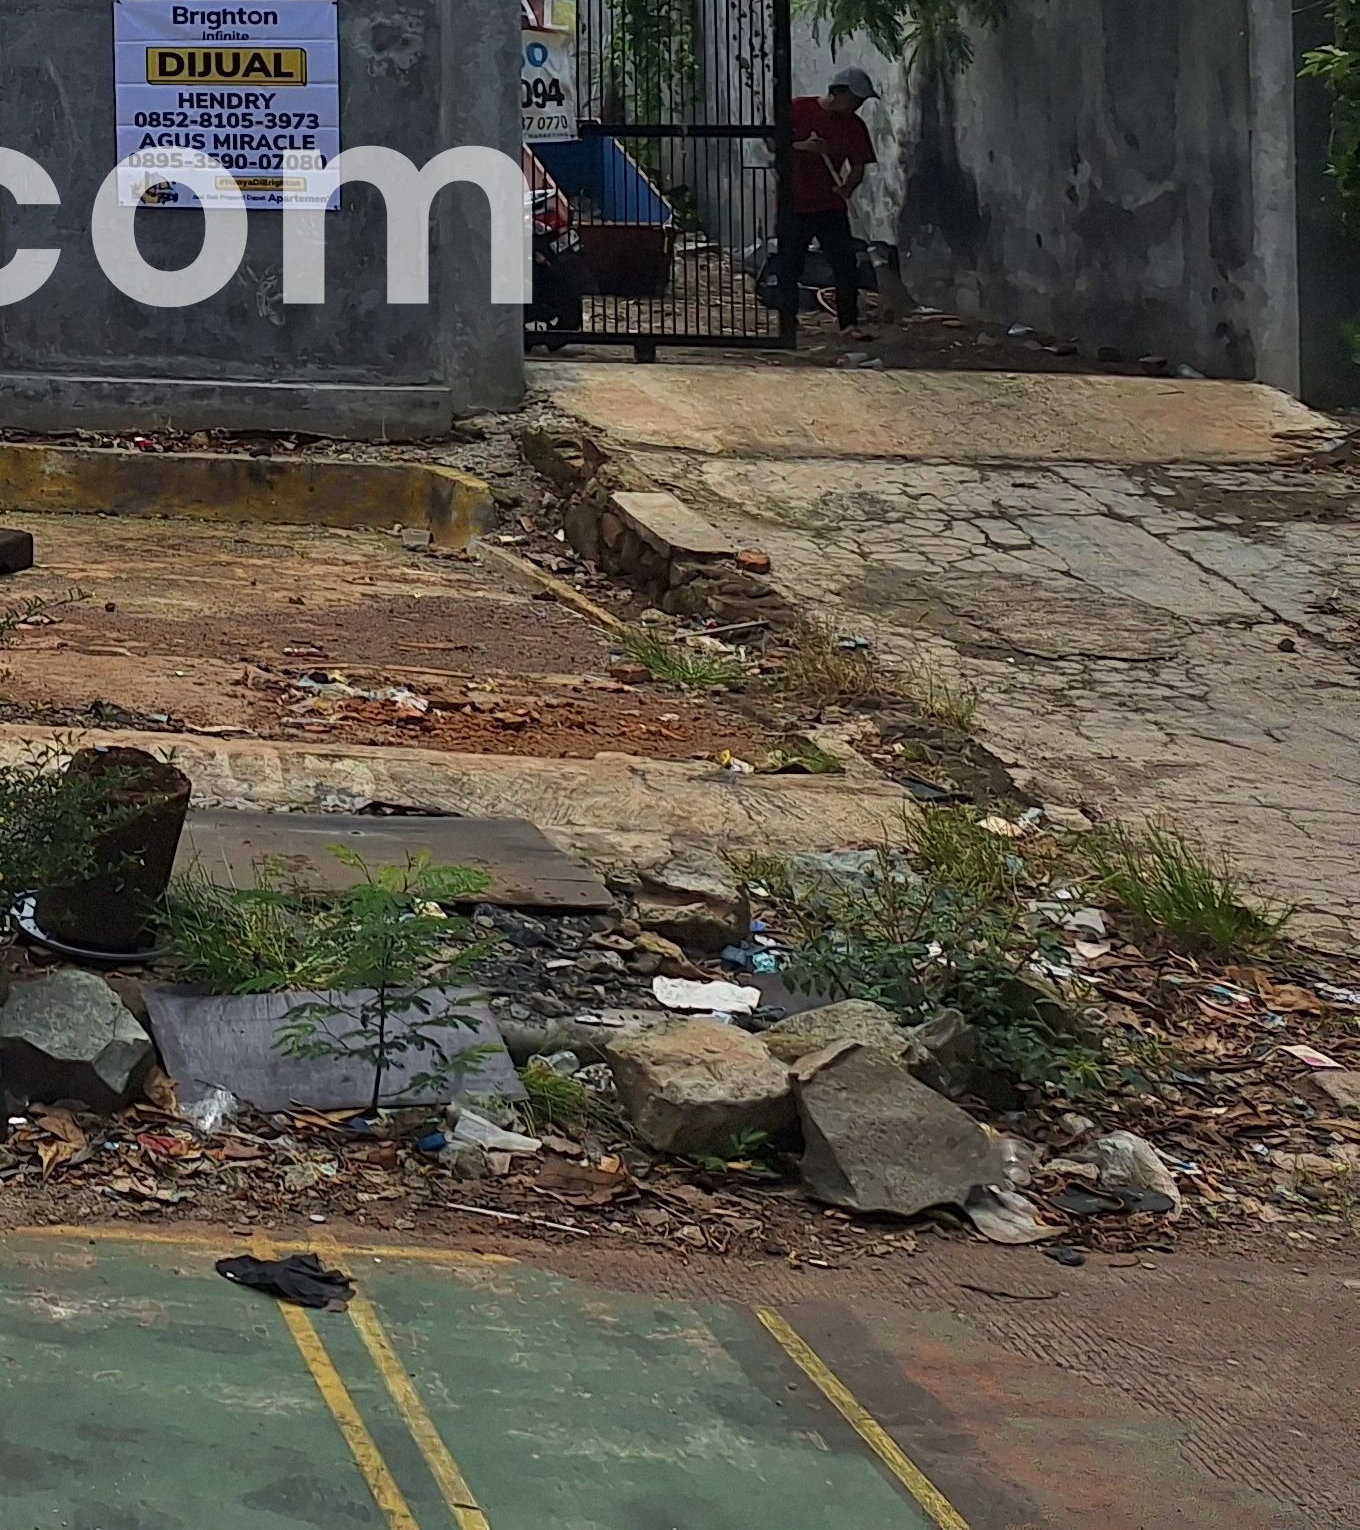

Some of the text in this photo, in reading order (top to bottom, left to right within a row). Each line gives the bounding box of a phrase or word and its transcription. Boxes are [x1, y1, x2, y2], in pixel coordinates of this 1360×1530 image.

[172, 6, 278, 30] Brighton
[202, 30, 250, 41] Infinite
[158, 52, 294, 78] DIJUAL
[178, 92, 276, 110] HENDRY
[134, 111, 320, 130] 0852-8105-3973
[537, 114, 568, 130] 0770
[139, 132, 315, 151] AGUS MIRACLE
[128, 153, 327, 170] 0895-3590-07080
